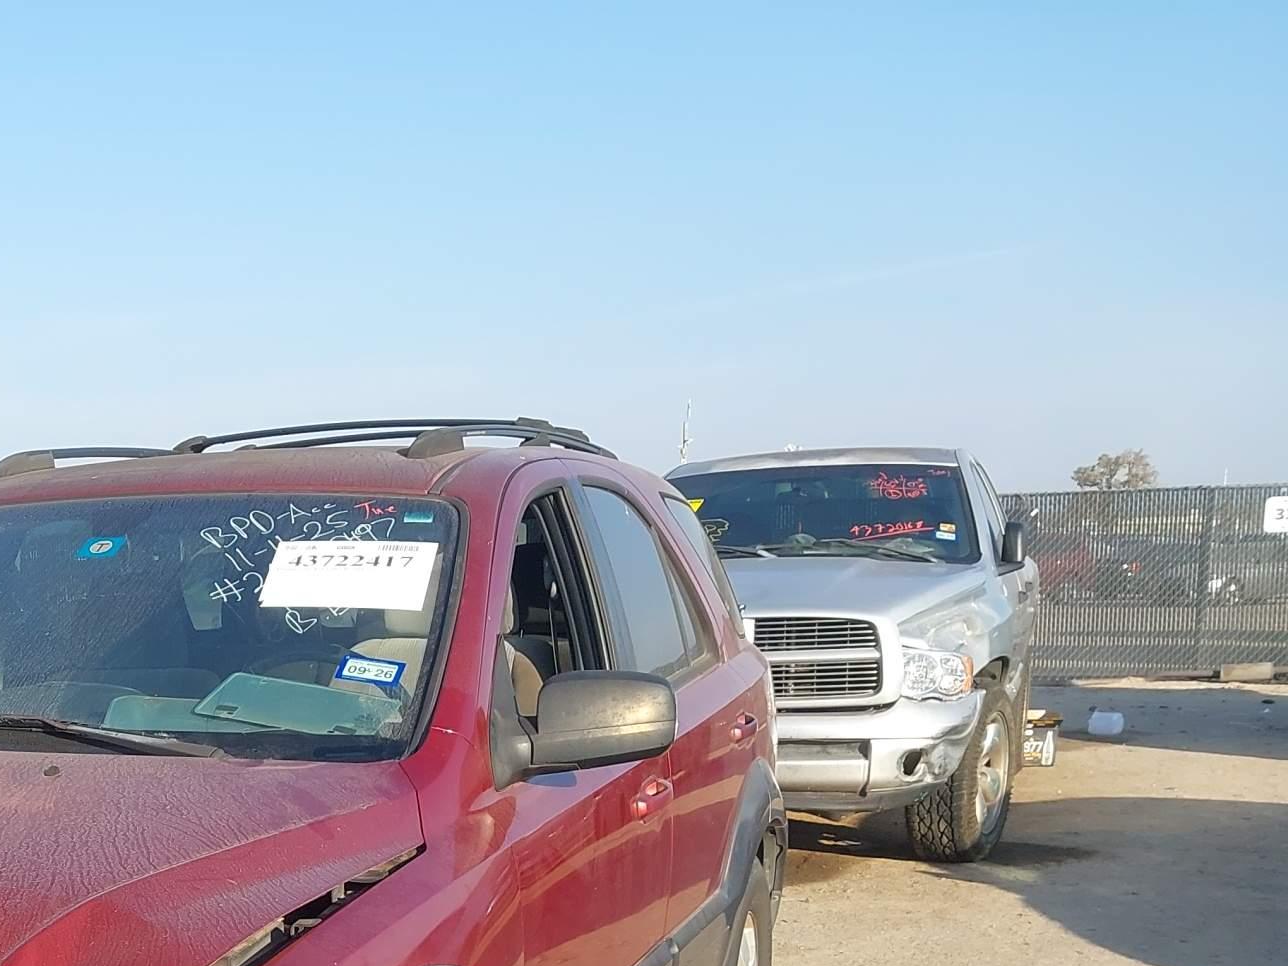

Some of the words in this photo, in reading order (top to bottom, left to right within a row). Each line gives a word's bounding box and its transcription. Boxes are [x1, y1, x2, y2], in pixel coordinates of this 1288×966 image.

[1275, 508, 1288, 520] 3
[288, 555, 414, 567] 43722417
[374, 668, 394, 680] 26
